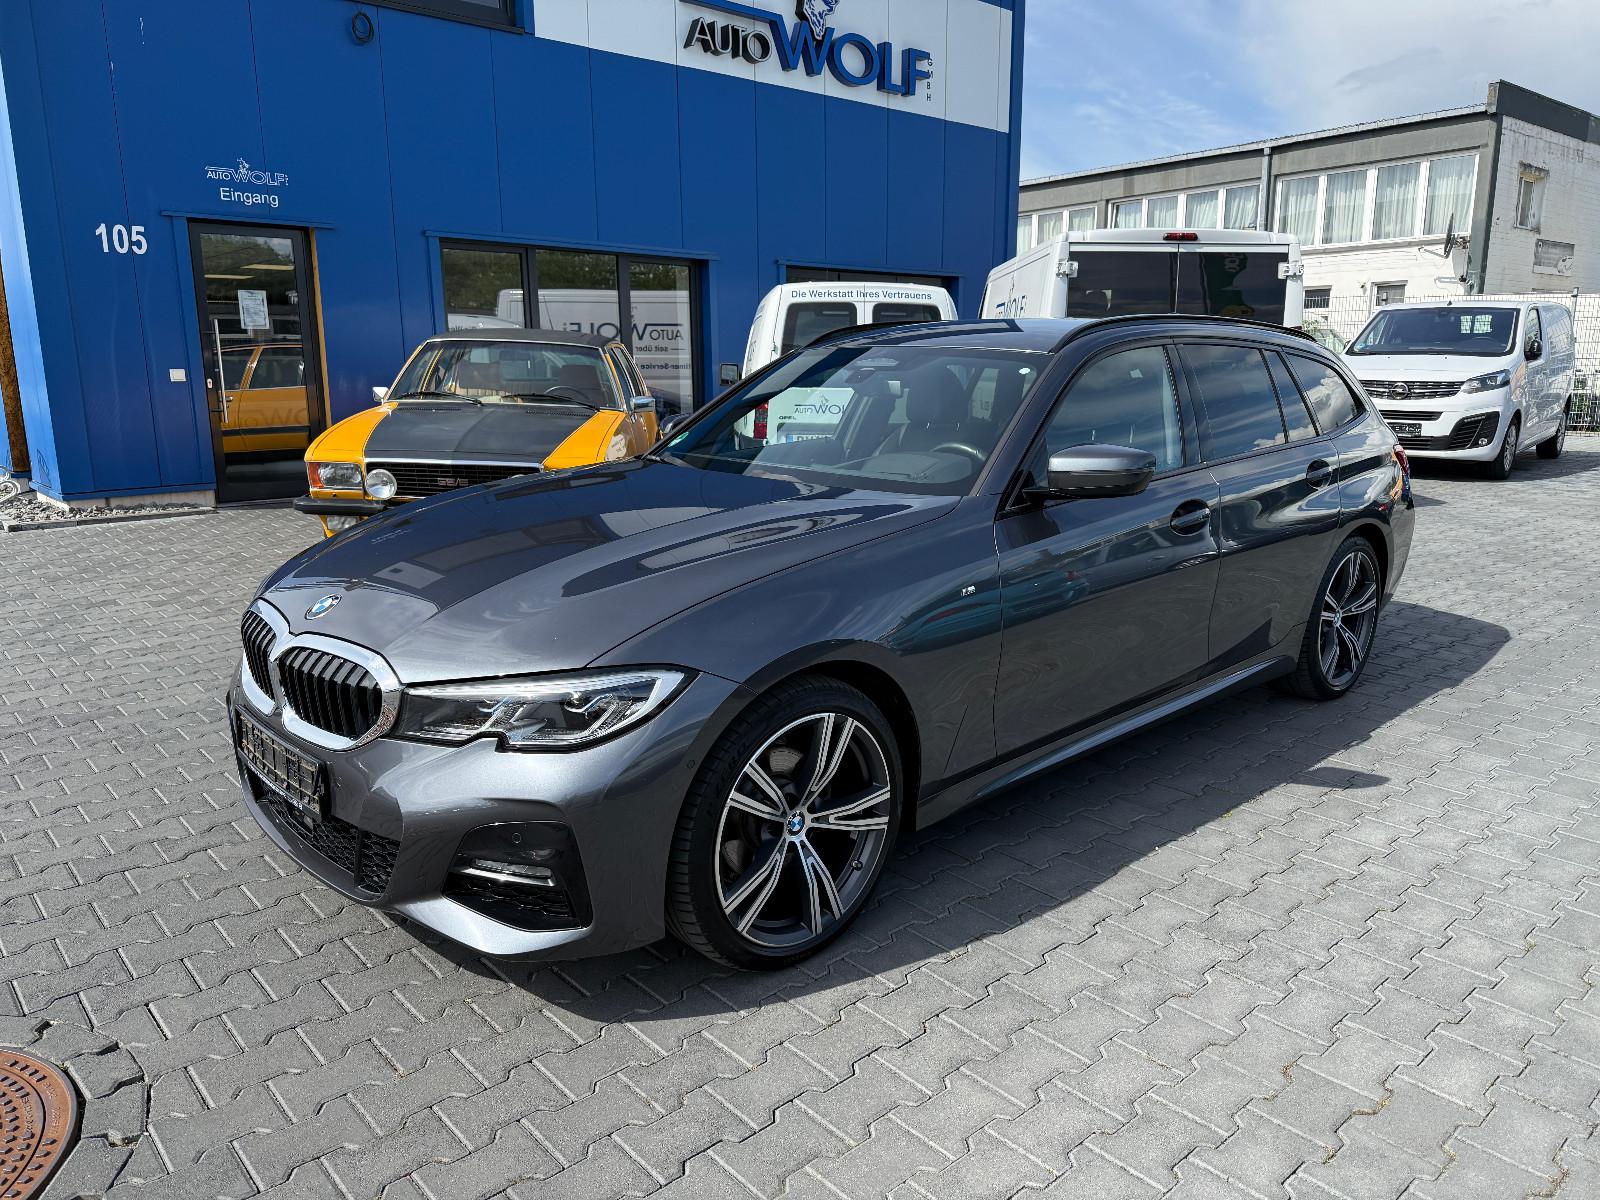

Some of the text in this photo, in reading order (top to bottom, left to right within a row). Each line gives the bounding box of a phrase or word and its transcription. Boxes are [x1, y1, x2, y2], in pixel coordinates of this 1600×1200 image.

[683, 17, 931, 97] AUTO WOLF
[206, 170, 231, 181] AUTO
[231, 169, 285, 186] WOLF
[220, 187, 279, 208] Eingang
[95, 223, 148, 255] 105
[791, 289, 932, 300] Die Werkstatt Ihres Vertrauens
[814, 404, 846, 415] WO
